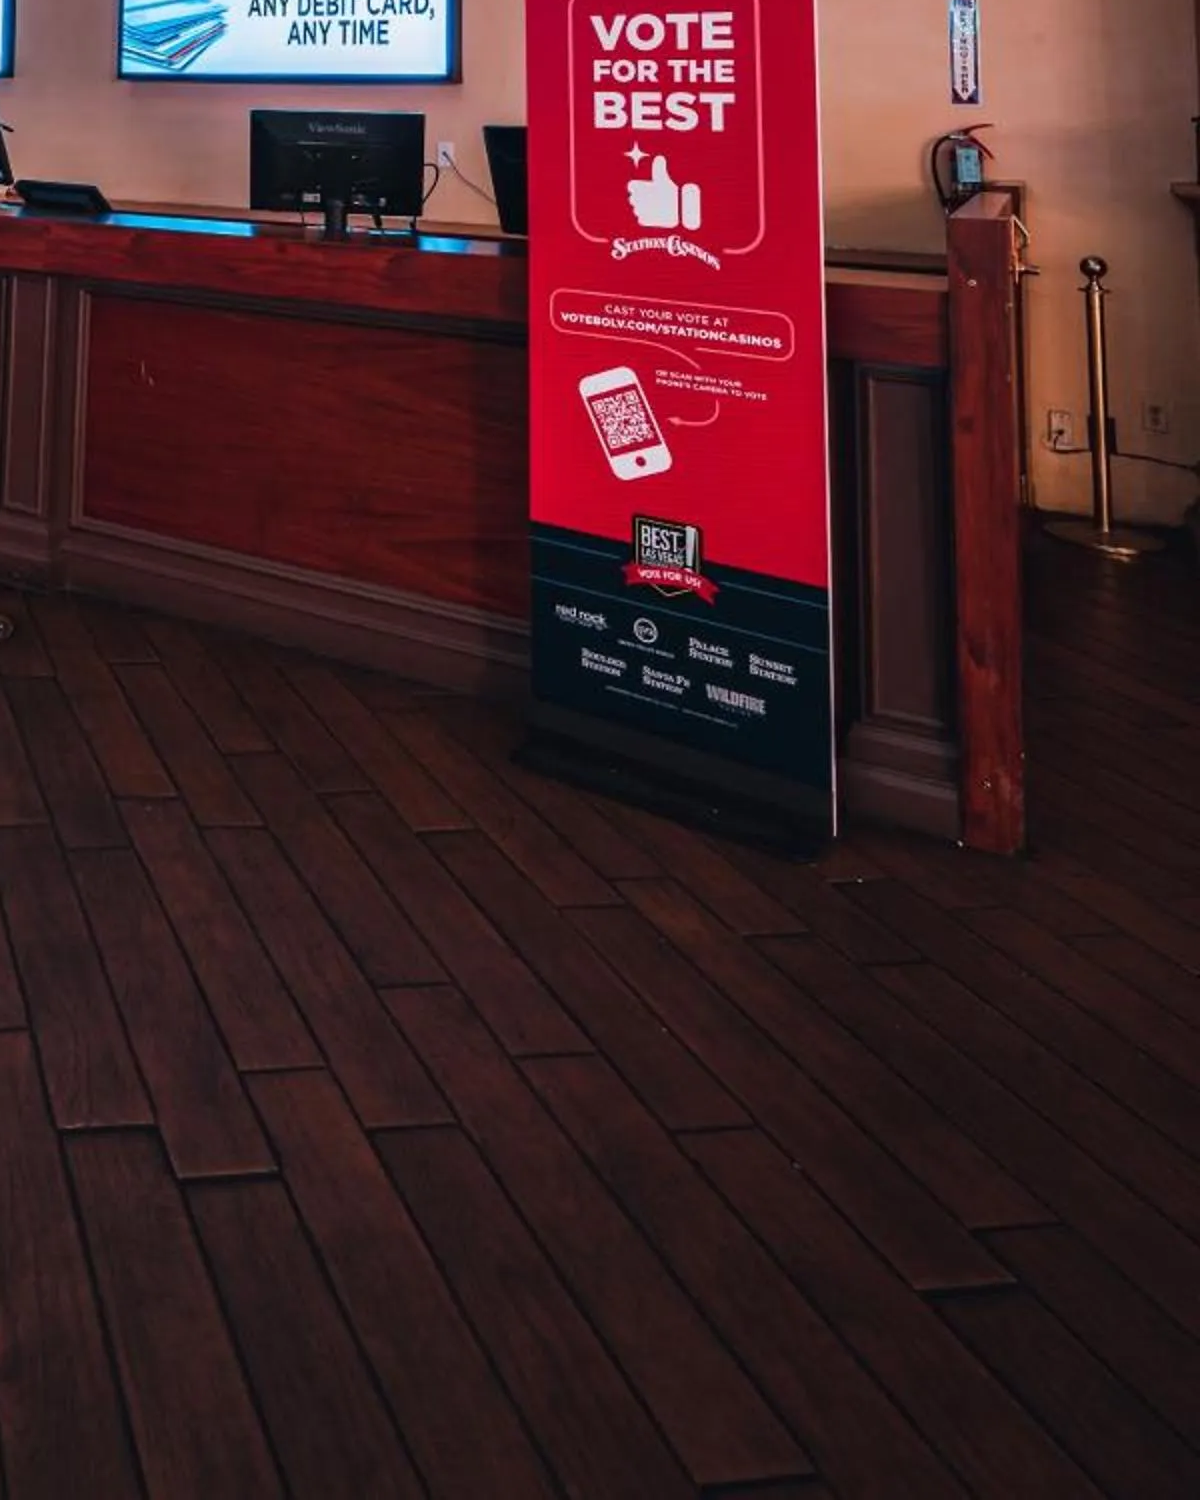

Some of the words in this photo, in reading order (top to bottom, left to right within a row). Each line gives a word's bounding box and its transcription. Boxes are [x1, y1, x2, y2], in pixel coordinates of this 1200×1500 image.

[287, 20, 333, 46] ANY
[339, 19, 391, 46] TIME
[589, 11, 736, 51] VOTE
[593, 59, 659, 83] FOR
[667, 59, 736, 83] THE
[593, 91, 736, 132] BEST
[604, 303, 636, 316] CAST
[639, 308, 673, 321] YOUR
[676, 312, 710, 326] VOTE
[713, 317, 730, 328] AT
[641, 524, 684, 553] BEST
[705, 683, 767, 716] WILDFIRE
